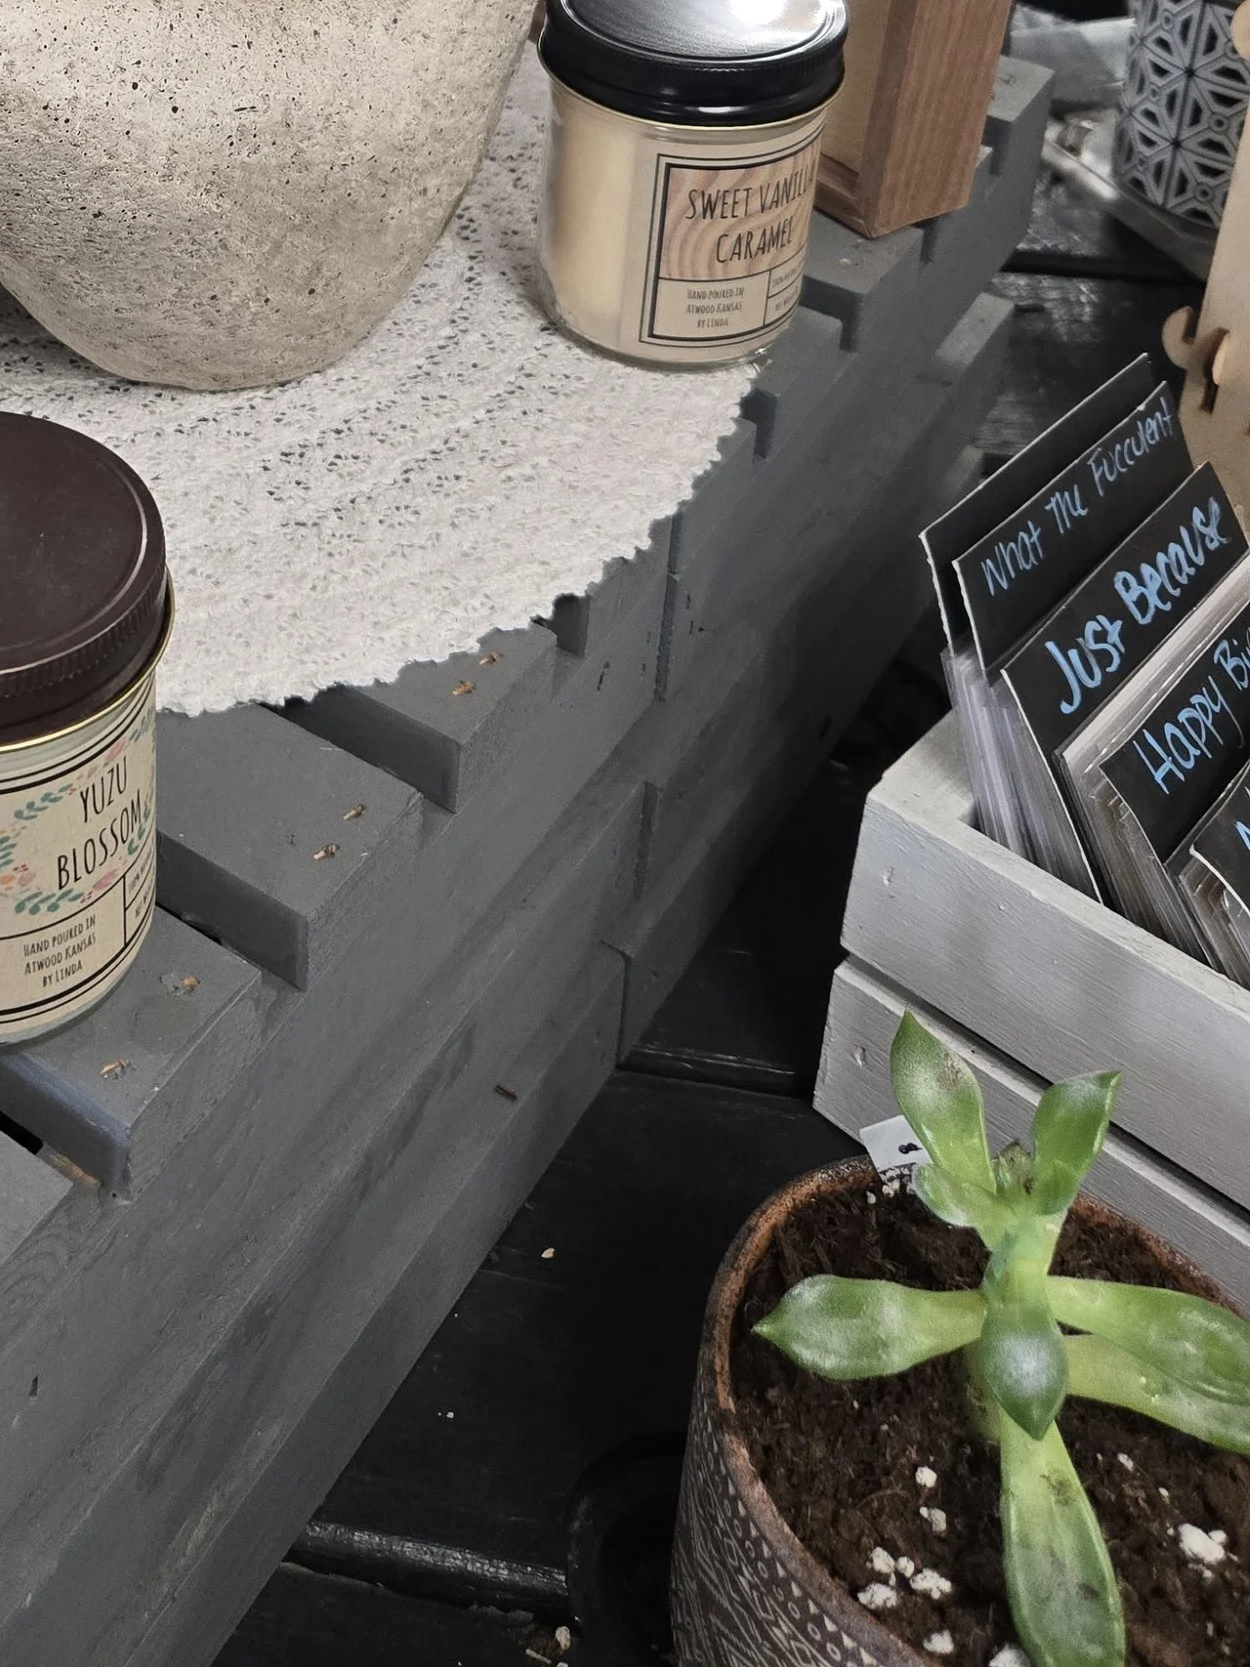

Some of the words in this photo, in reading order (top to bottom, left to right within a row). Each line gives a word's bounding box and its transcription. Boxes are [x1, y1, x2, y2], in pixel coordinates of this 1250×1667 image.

[685, 187, 753, 220] SWEET
[716, 216, 794, 264] CARAMEL
[685, 304, 715, 315] ATWOOD
[716, 302, 743, 313] KANSAS
[686, 289, 706, 300] HAND
[708, 288, 733, 300] POURED
[734, 287, 745, 297] IN
[697, 319, 706, 329] BY
[980, 520, 1044, 597] What
[1132, 675, 1245, 796] Happy
[80, 755, 127, 823] YUZU
[57, 788, 142, 891] BLOSSOM
[23, 939, 50, 957] HAND
[51, 923, 84, 948] POURED
[85, 914, 96, 930] IN
[24, 953, 63, 975] ATWOOD
[64, 932, 97, 960] KANSAS
[42, 975, 53, 988] BY
[55, 959, 83, 983] LINDA
